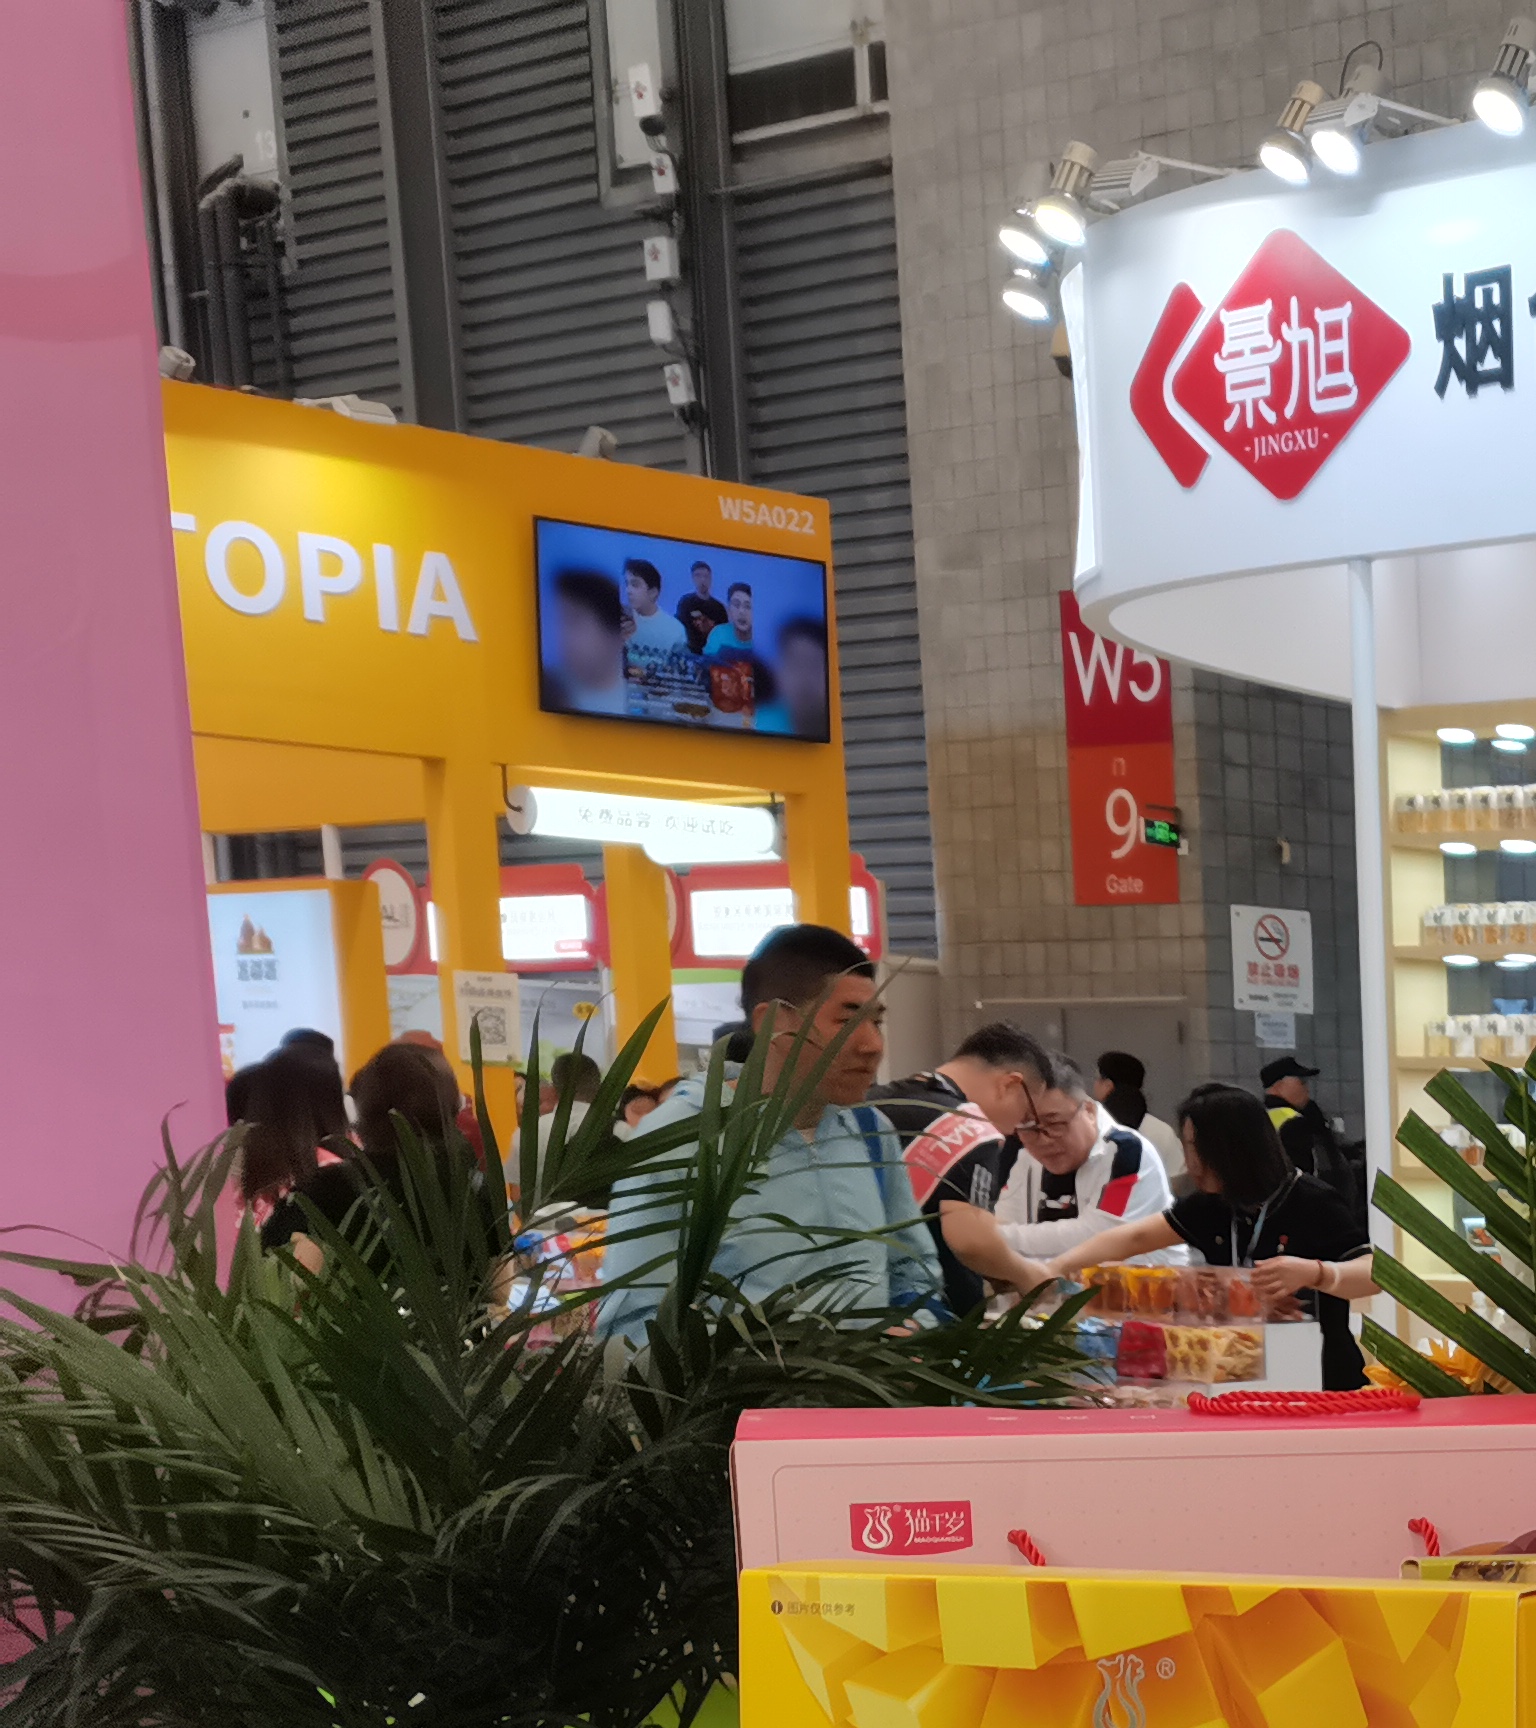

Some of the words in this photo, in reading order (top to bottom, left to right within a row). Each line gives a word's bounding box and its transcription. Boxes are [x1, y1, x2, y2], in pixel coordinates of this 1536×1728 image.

[1214, 297, 1359, 433] 景旭
[717, 495, 815, 536] W5A022
[1068, 632, 1162, 706] W5
[1105, 788, 1138, 859] 9
[1106, 874, 1144, 894] Gate
[786, 1602, 856, 1617] 图片仅供参考
